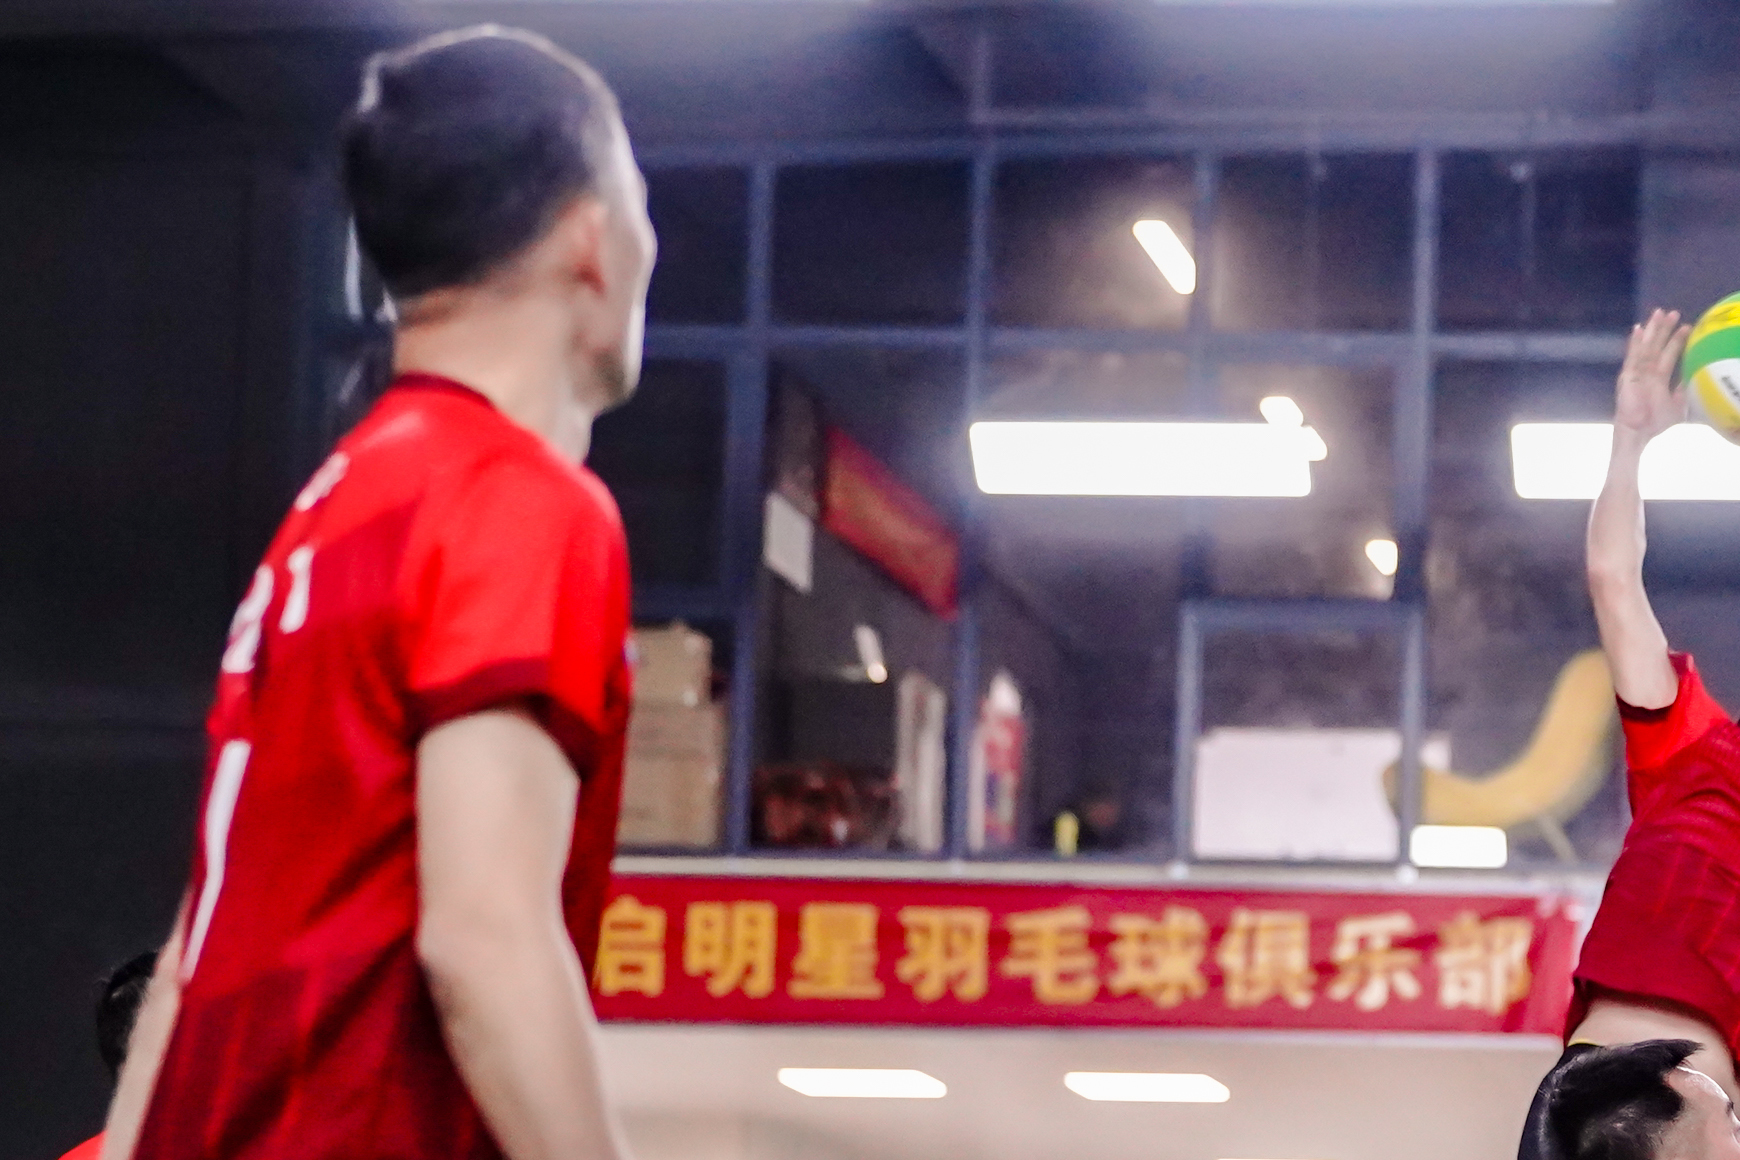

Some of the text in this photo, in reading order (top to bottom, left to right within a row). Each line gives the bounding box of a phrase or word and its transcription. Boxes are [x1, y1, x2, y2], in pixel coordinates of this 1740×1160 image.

[595, 895, 1536, 1013] 启明星羽毛球俱乐部
